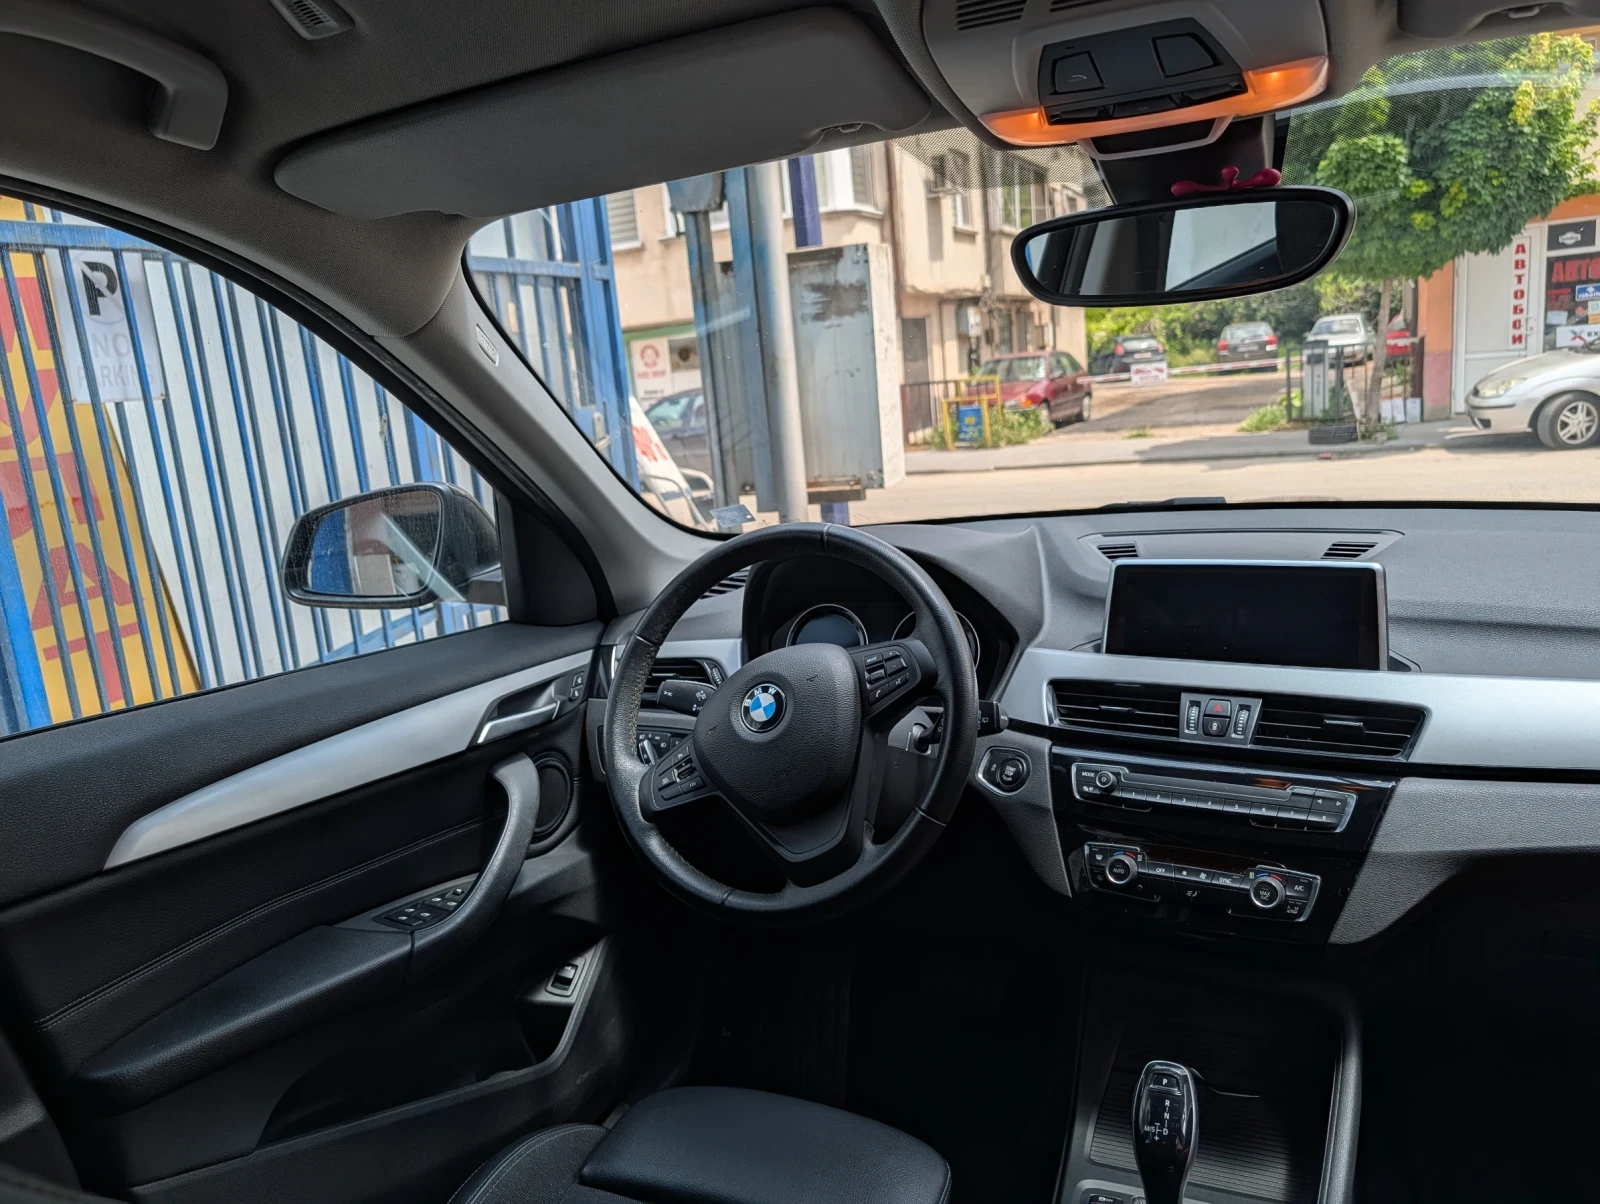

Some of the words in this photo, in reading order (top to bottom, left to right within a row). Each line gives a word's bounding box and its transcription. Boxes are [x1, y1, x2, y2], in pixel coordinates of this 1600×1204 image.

[92, 332, 131, 359] NO
[76, 363, 155, 389] PRKIG
[744, 686, 777, 707] BMW
[1162, 1078, 1168, 1086] P
[1164, 1099, 1171, 1107] R
[1163, 1112, 1170, 1120] N
[1143, 1125, 1156, 1133] M/S
